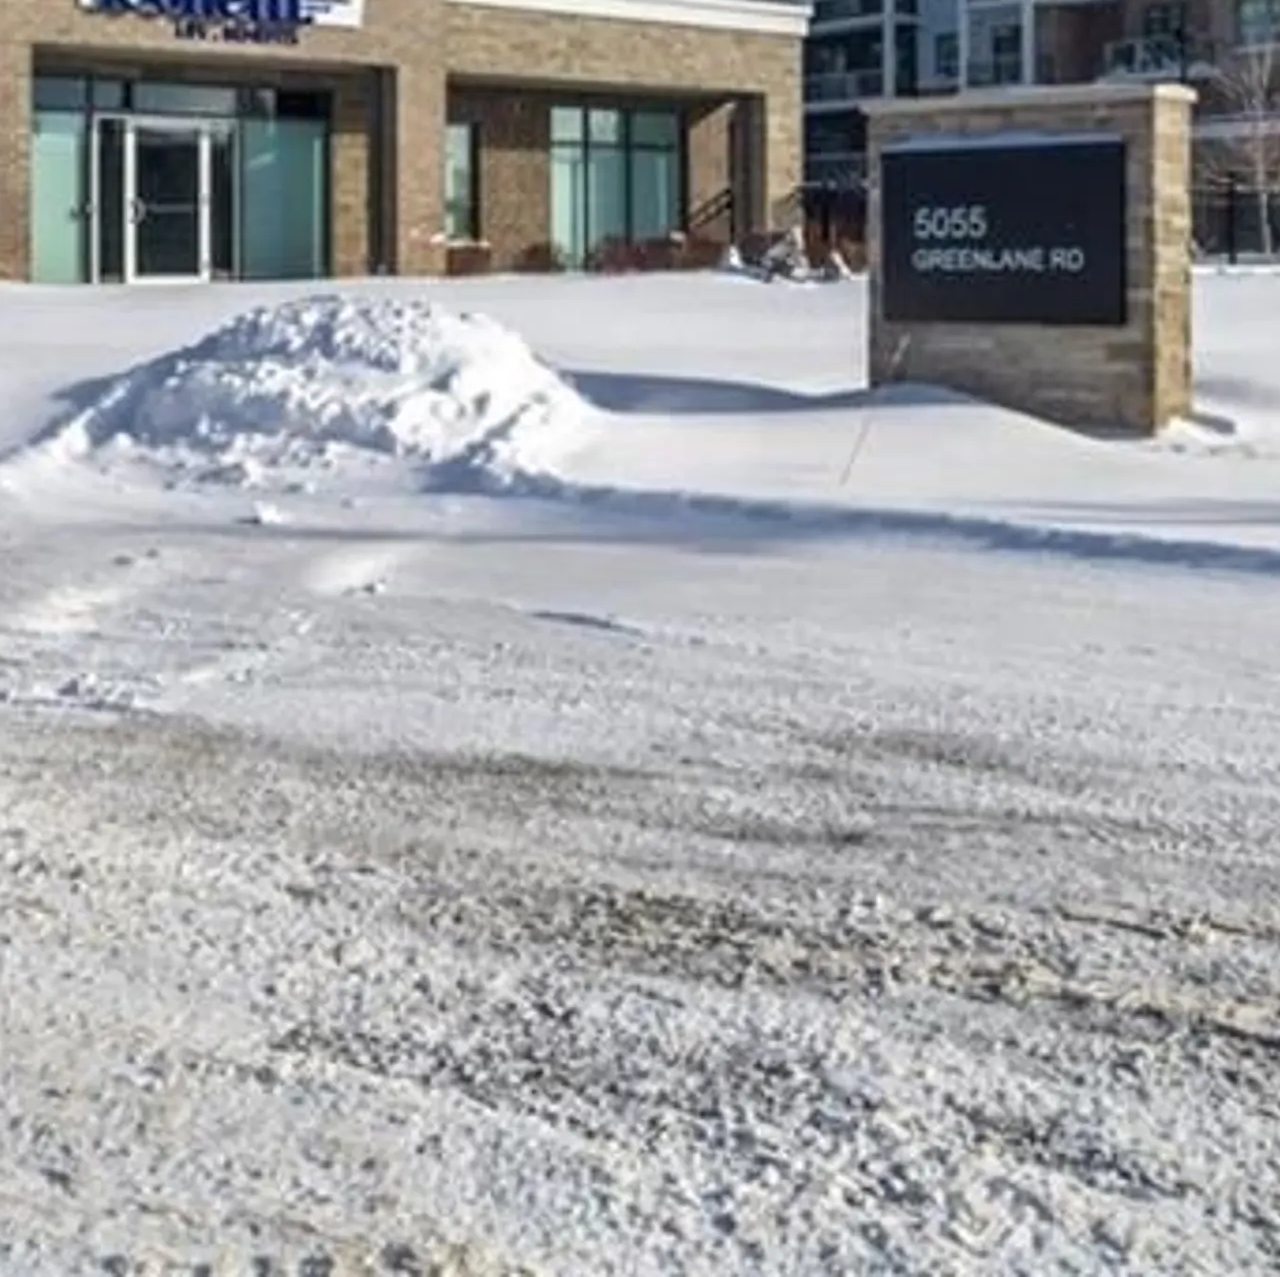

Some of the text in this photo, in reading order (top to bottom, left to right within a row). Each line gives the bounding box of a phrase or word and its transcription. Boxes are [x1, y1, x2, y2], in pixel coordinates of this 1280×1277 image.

[913, 205, 988, 238] 5055
[911, 246, 1084, 271] GREENLANE RD
